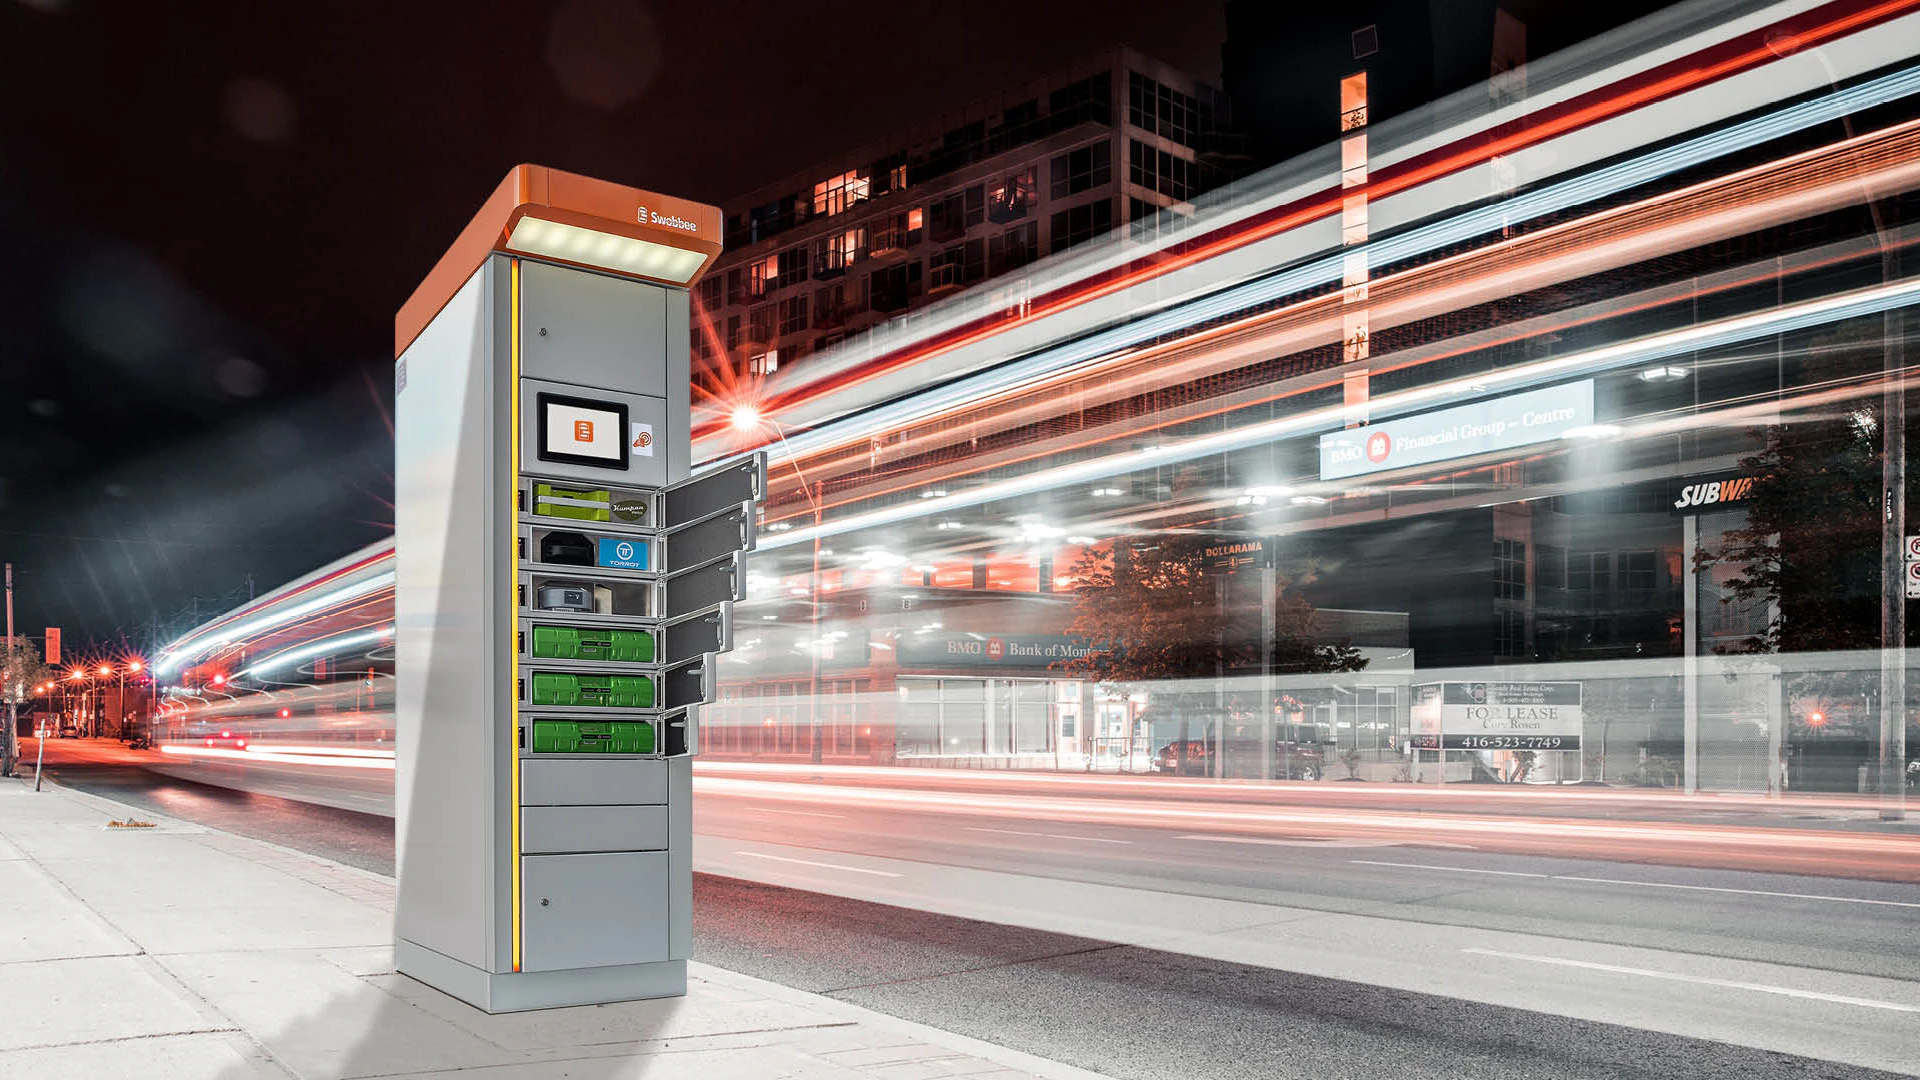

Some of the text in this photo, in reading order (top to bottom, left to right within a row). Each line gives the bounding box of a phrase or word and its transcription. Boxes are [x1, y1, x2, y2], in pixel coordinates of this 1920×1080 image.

[651, 211, 697, 232] Swobbee
[1331, 446, 1363, 464] BMO
[1395, 427, 1458, 452] Financial
[1460, 421, 1506, 440] Group
[1522, 407, 1575, 427] Centre
[1674, 477, 1753, 509] SUBWA
[1205, 541, 1263, 557] DOLLARAMA
[609, 560, 640, 568] TORROT
[948, 640, 981, 655] BMO
[1010, 643, 1042, 656] Bank
[1045, 644, 1059, 656] of
[1507, 707, 1558, 720] LEASE
[1510, 719, 1540, 729] Rosen
[1462, 736, 1561, 748] 416-523-7749
